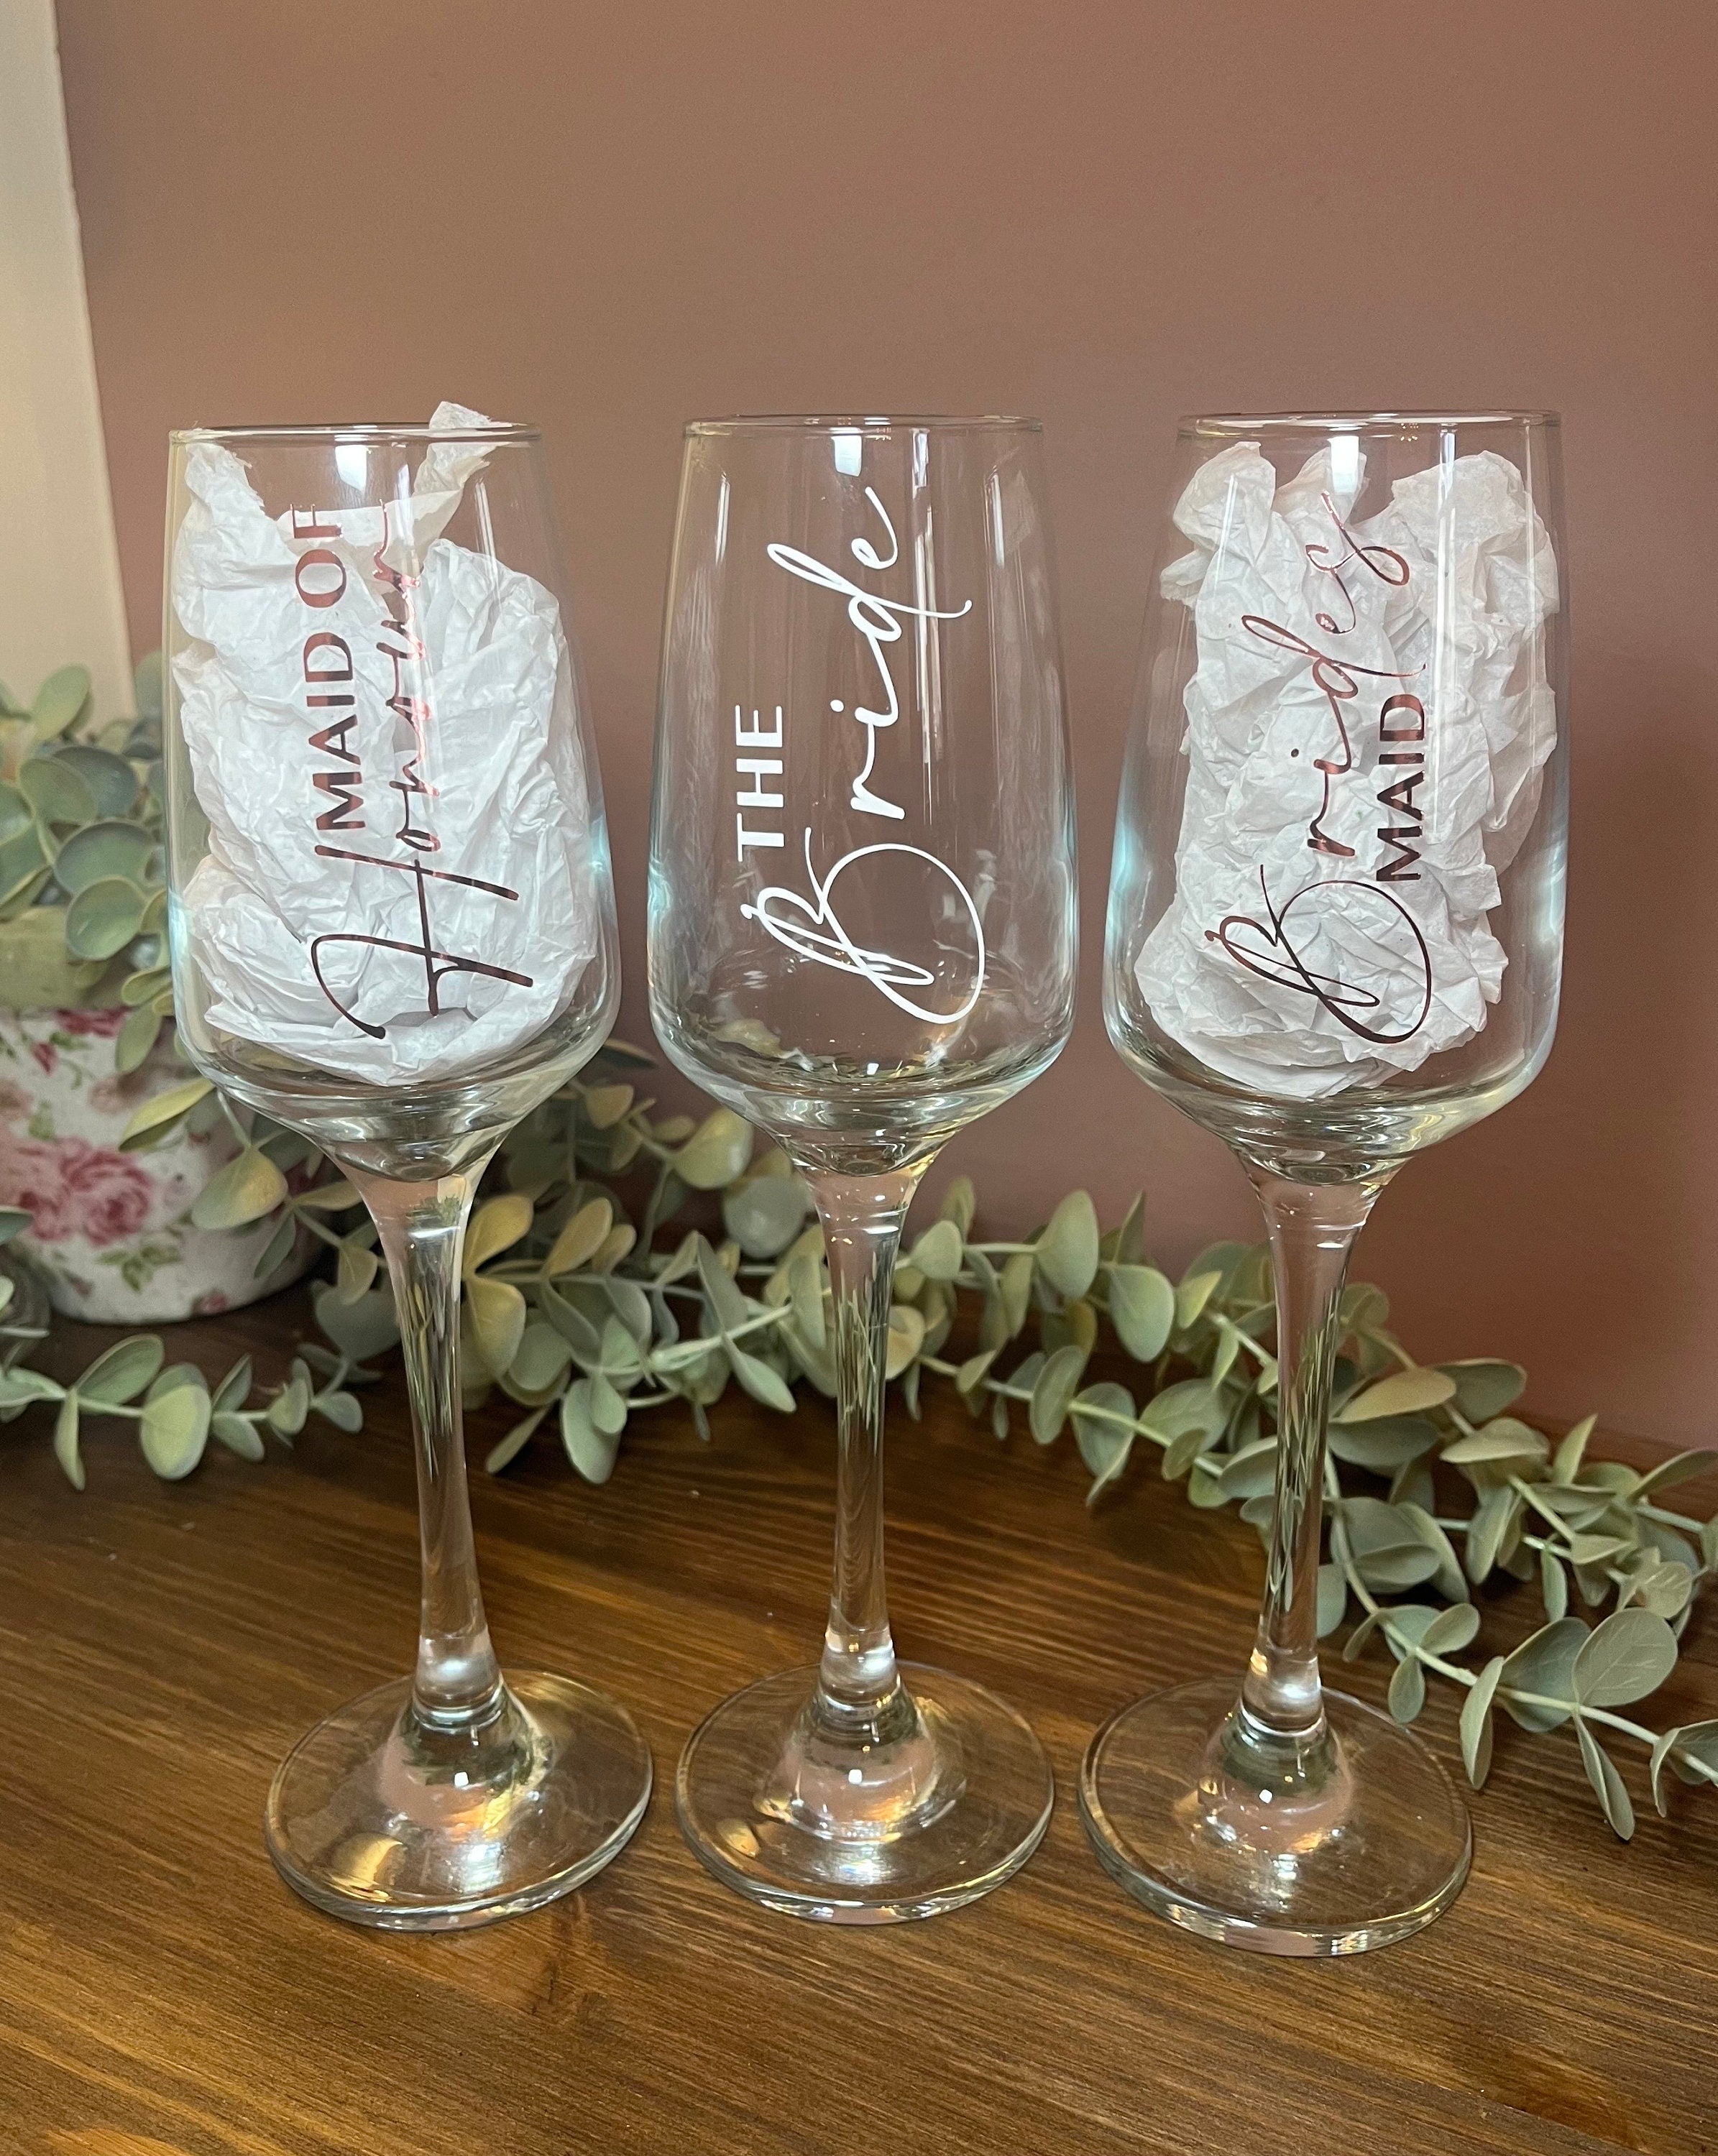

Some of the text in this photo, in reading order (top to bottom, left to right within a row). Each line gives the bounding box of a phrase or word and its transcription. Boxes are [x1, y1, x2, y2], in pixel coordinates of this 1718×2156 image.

[290, 503, 366, 830] MAID OF
[311, 498, 533, 1038] Honour
[735, 704, 784, 862] THE
[740, 486, 985, 1024] Bride
[1205, 491, 1432, 1044] Brides
[1375, 694, 1426, 882] MAID
